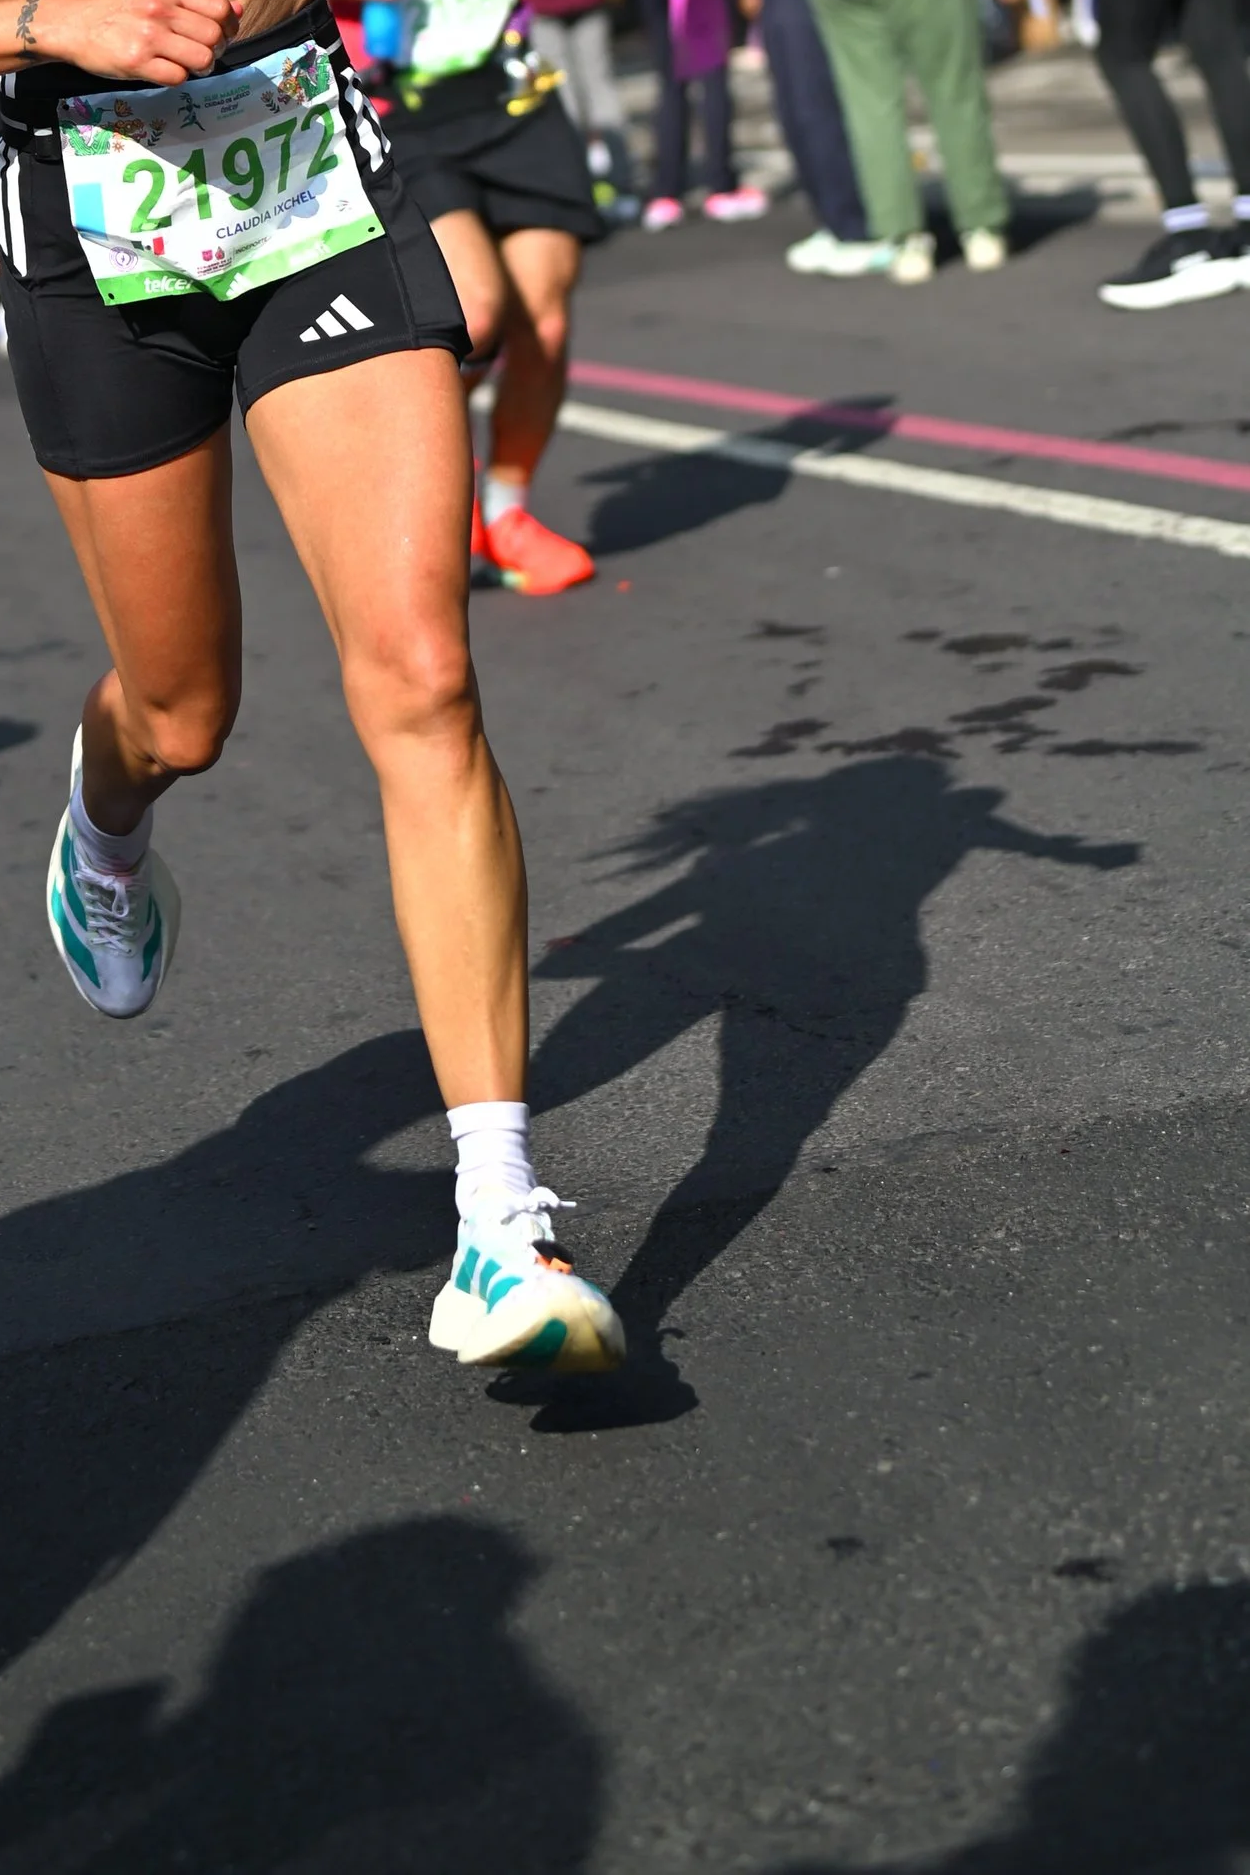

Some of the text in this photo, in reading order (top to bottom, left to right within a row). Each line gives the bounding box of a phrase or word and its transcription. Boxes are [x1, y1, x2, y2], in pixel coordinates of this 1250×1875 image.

[122, 103, 339, 233] 21972
[216, 189, 316, 239] CLAUDIA IXCHEL
